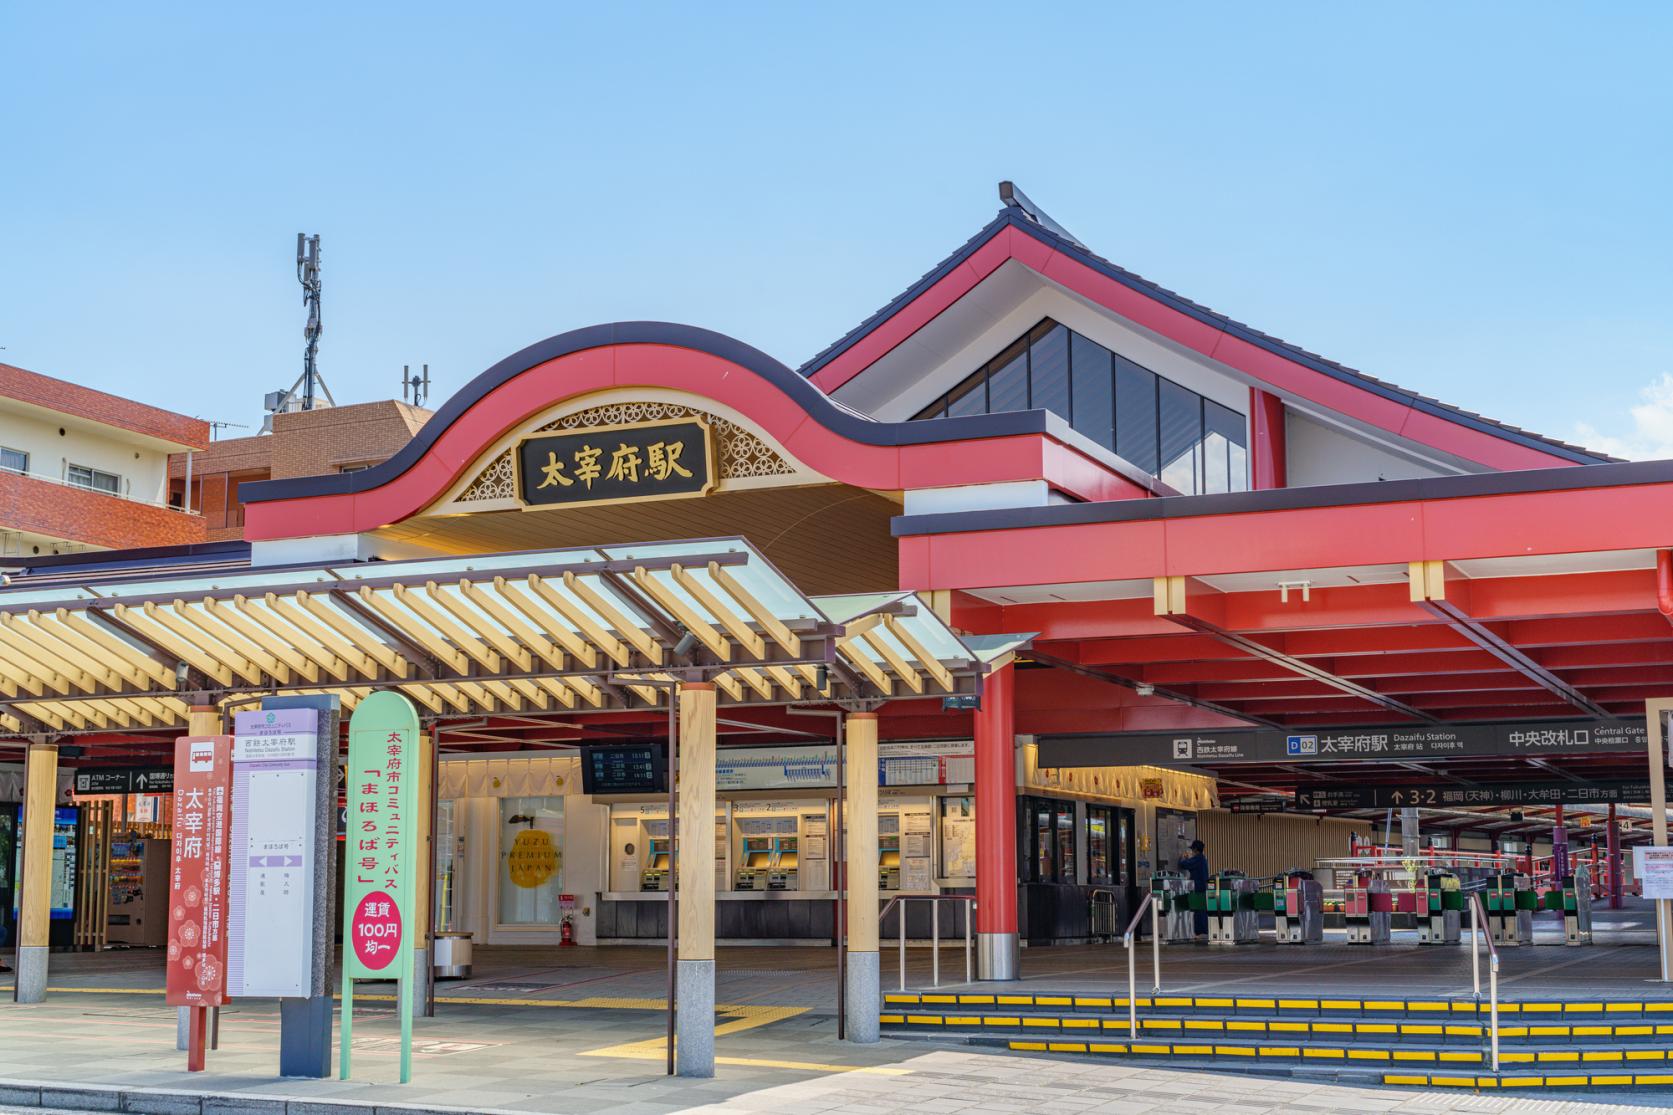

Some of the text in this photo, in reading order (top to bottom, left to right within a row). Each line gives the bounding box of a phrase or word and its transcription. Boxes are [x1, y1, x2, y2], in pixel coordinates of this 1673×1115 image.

[536, 441, 694, 491] 太宰府駅
[1393, 732, 1457, 742] Dazaifu Station
[1509, 730, 1589, 747] 中央改札口
[1594, 727, 1646, 736] Central Gate
[1291, 741, 1314, 750] D 02
[1321, 735, 1388, 753] 太宰府駅
[176, 789, 184, 828] Dazaifu
[385, 731, 402, 889] 太宰府市コミュニティバス
[640, 806, 645, 814] 5
[766, 803, 771, 812] 2
[184, 787, 204, 858] 太宰府
[357, 769, 381, 883] 「まほろば号」
[1623, 821, 1629, 830] 4
[514, 838, 549, 846] YUZU
[501, 852, 562, 860] PREMIUM
[511, 864, 551, 873] JAPAN
[364, 902, 391, 918] 運賃
[358, 923, 398, 938] 100円
[365, 939, 391, 955] 均一
